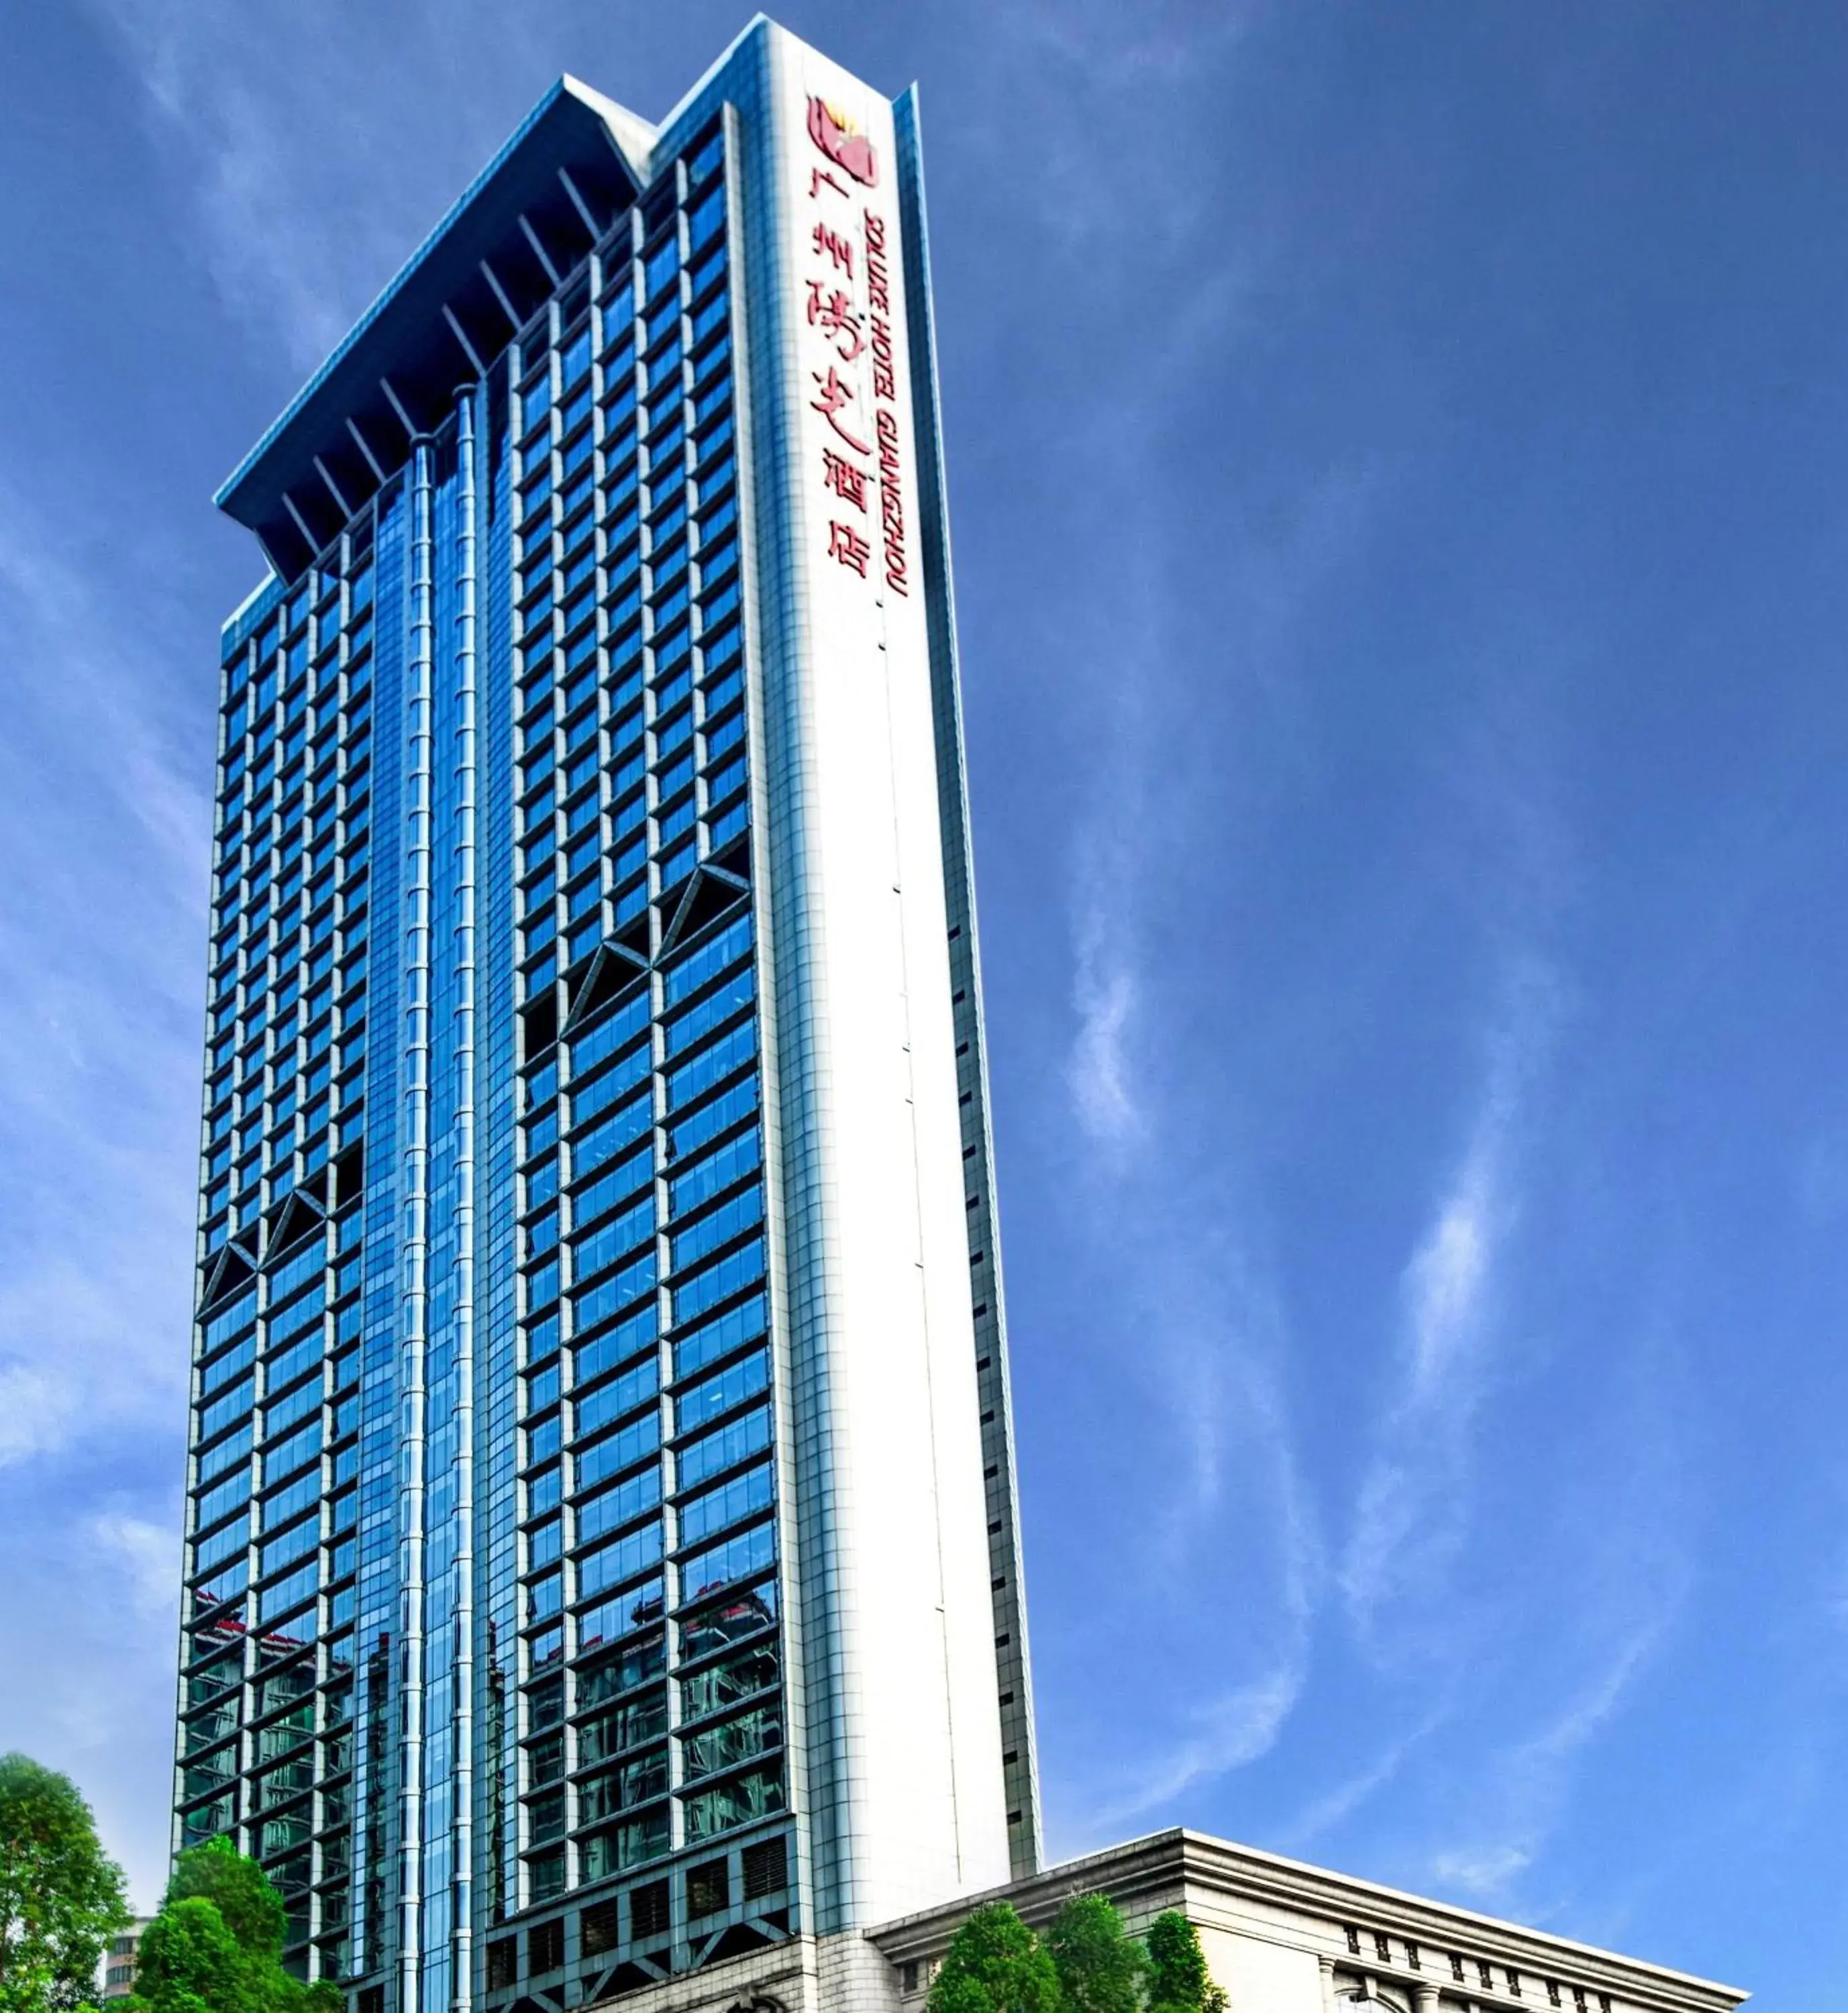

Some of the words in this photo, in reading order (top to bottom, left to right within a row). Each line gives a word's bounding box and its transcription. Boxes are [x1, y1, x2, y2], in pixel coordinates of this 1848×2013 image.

[864, 207, 890, 315] SOLUXE
[871, 313, 896, 401] HOTEL
[876, 408, 908, 597] GUANGZHOU
